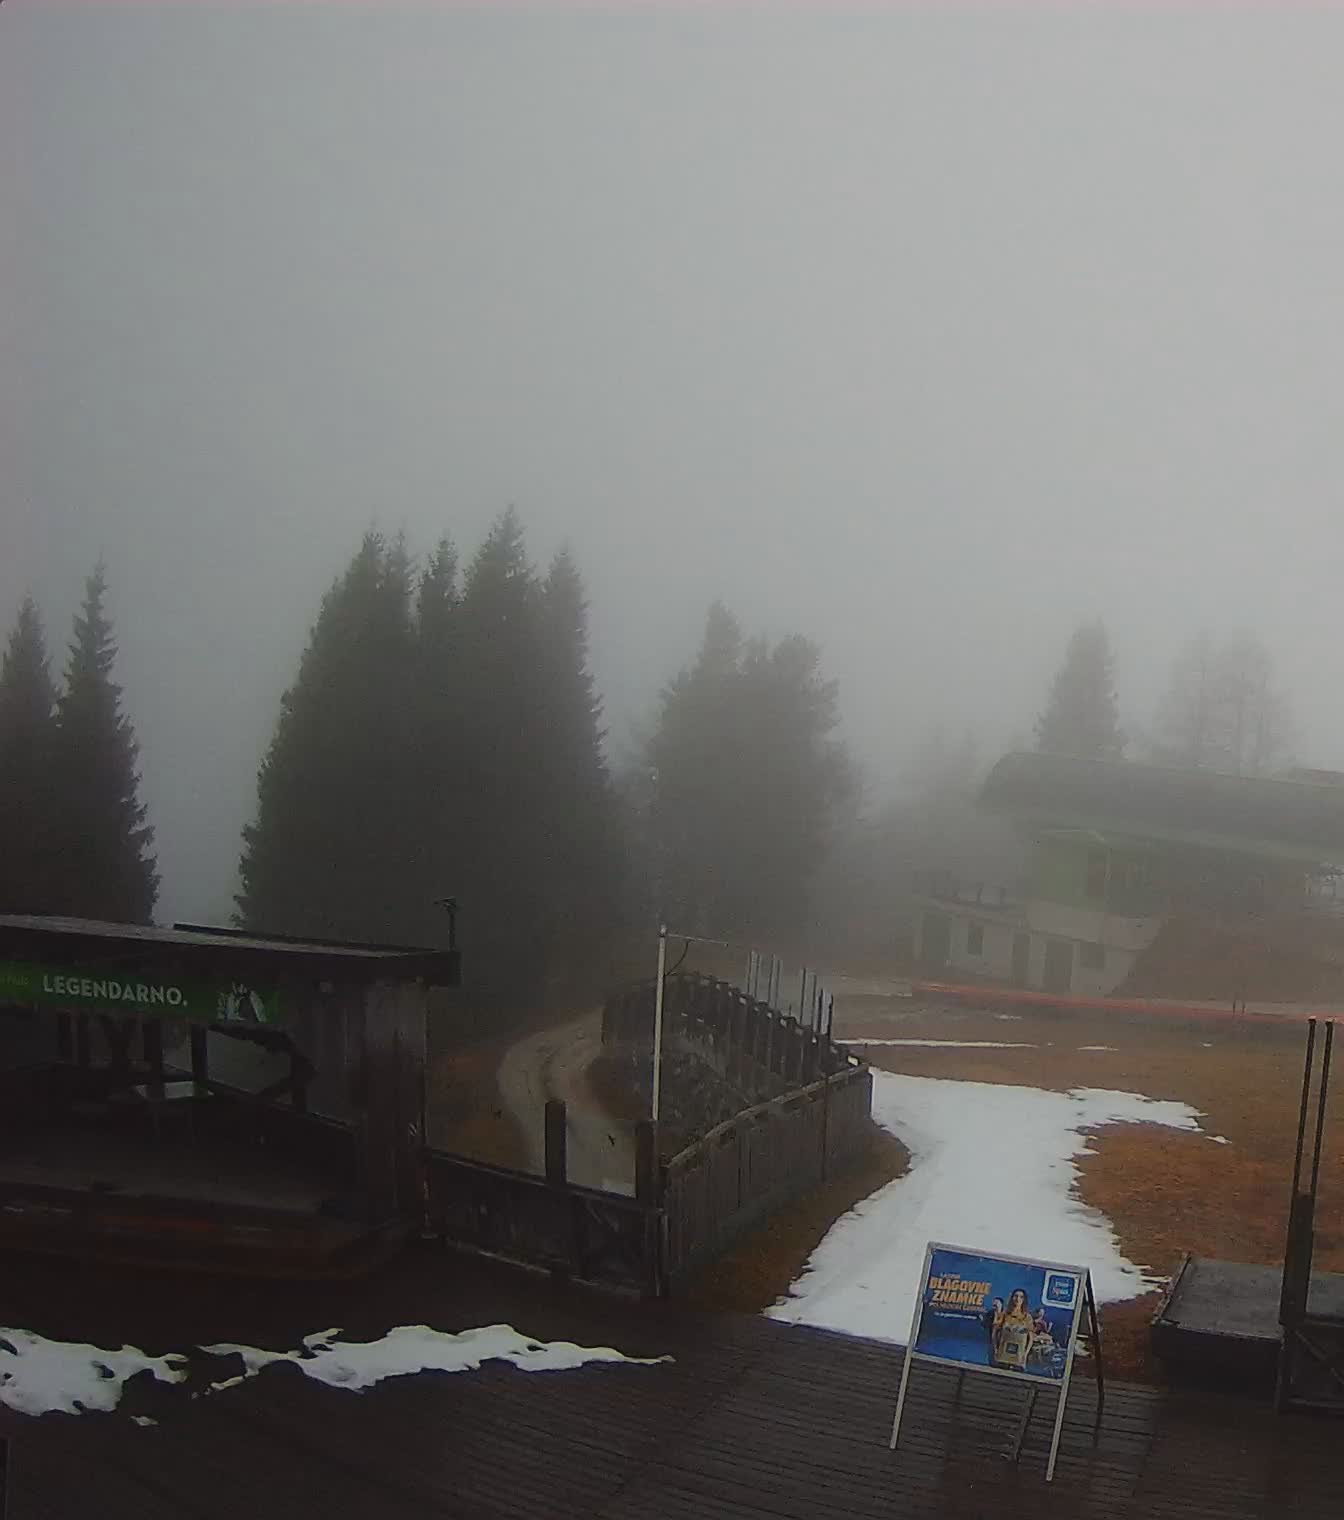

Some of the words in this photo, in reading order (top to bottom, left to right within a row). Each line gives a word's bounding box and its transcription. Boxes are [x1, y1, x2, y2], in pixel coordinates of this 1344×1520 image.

[43, 975, 188, 1007] LEGENDARNO.
[929, 1277, 991, 1295] BLAGOVNE
[932, 1290, 984, 1306] ZNAMKE
